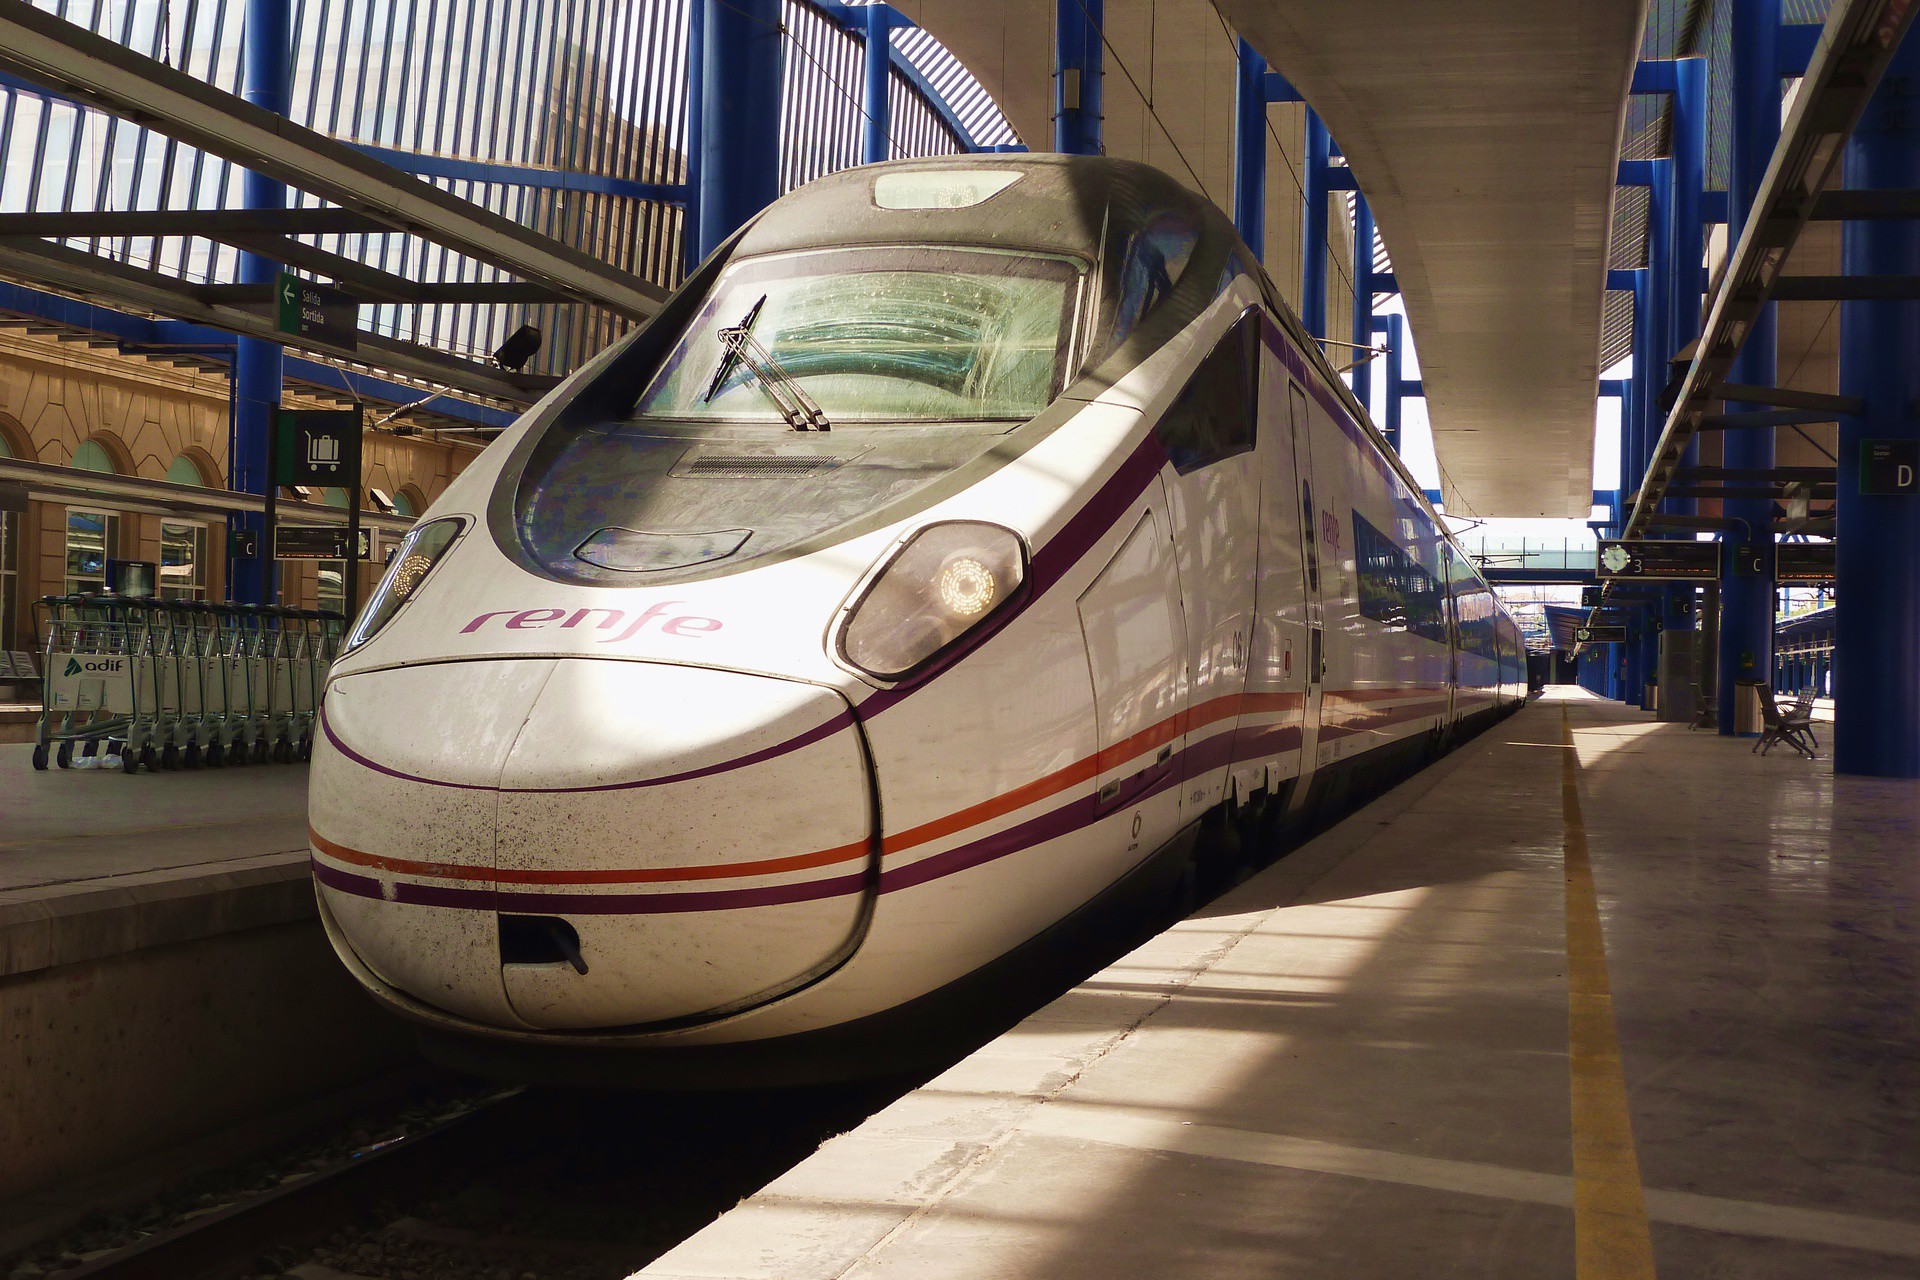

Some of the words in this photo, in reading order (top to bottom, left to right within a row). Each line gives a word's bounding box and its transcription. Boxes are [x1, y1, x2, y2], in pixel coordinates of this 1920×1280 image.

[302, 290, 320, 306] Salida
[302, 308, 324, 324] Sortida
[1898, 465, 1912, 487] D
[1322, 496, 1340, 567] renfe
[246, 542, 253, 555] C
[334, 544, 342, 557] 1
[1633, 559, 1642, 573] 3
[1753, 558, 1761, 572] C
[1584, 595, 1589, 604] 3
[459, 601, 723, 643] renfe
[85, 659, 123, 671] adif
